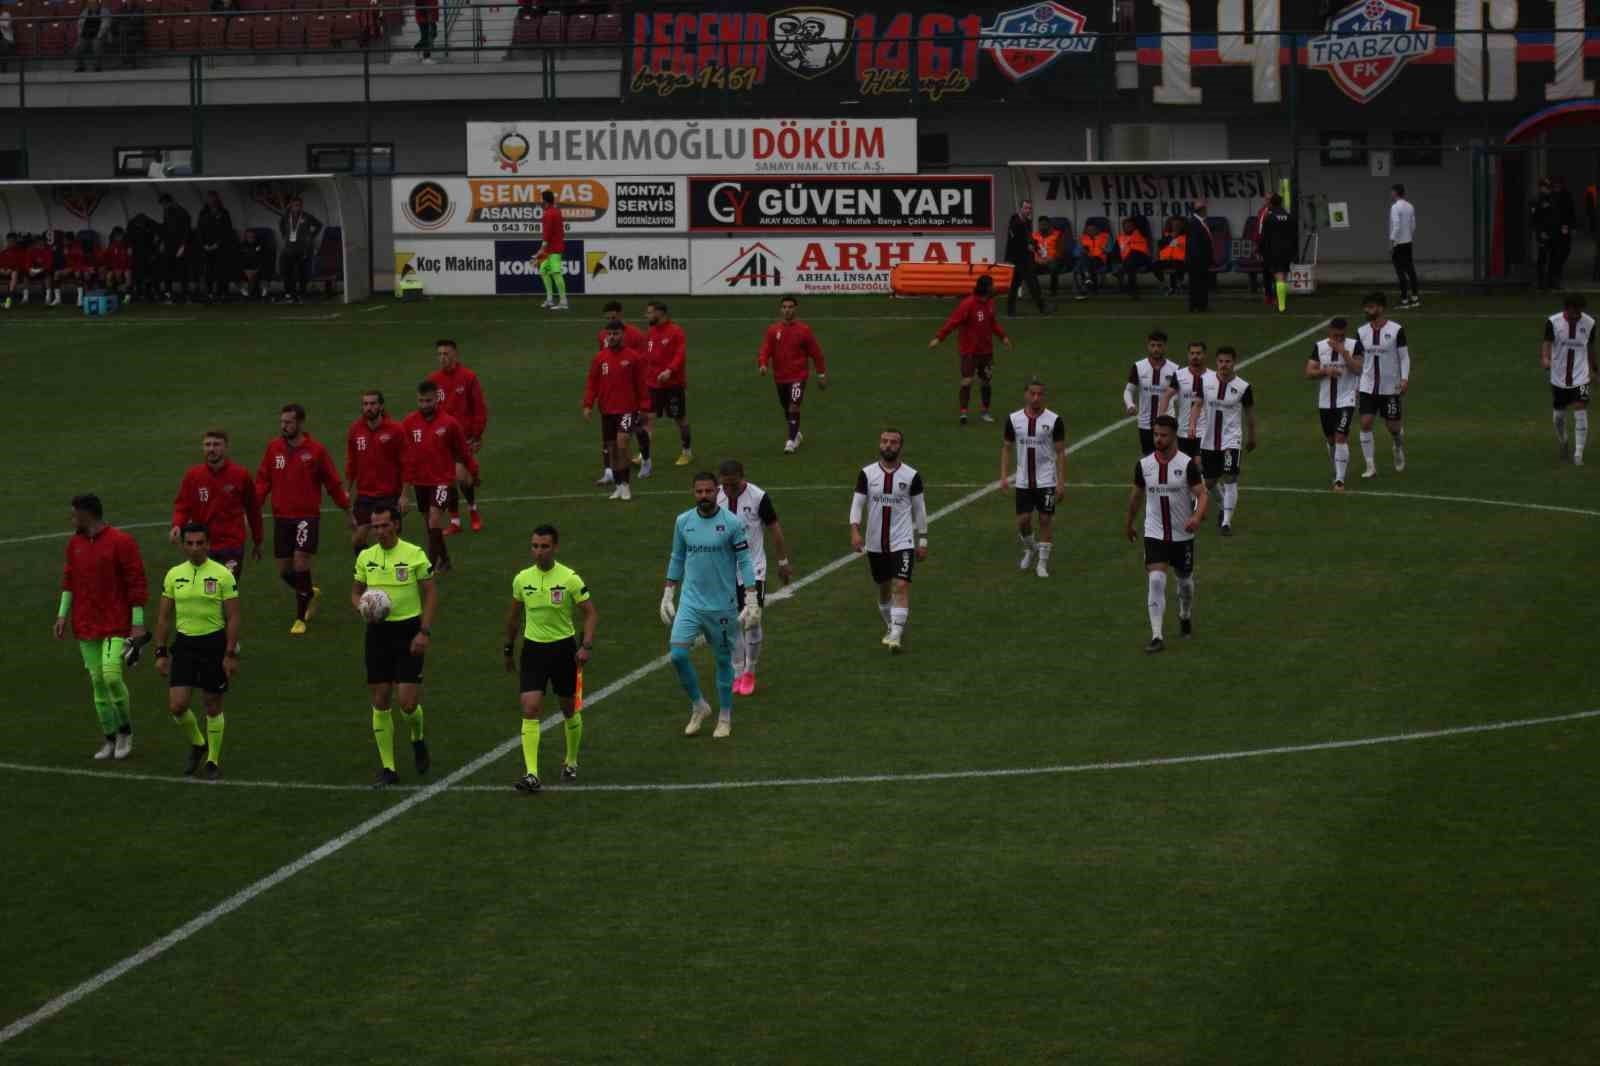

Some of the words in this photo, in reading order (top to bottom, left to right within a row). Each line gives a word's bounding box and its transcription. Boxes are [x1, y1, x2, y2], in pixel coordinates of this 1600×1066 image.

[1019, 22, 1057, 33] 1461
[633, 14, 767, 82] LEGEND
[855, 14, 979, 80] 1461
[1313, 33, 1429, 62] TRABZON
[1353, 62, 1379, 78] FK
[537, 120, 745, 161] HEKİMOĞLU
[753, 120, 885, 160] DÖKÜM
[617, 184, 674, 196] MONTAJ
[617, 197, 674, 211] SERVİS
[758, 183, 881, 216] GÜVEN
[892, 188, 973, 216] YAPI
[417, 256, 441, 273] Koç
[445, 255, 493, 272] Makina
[609, 255, 633, 272] Koç
[638, 254, 687, 271] Makina
